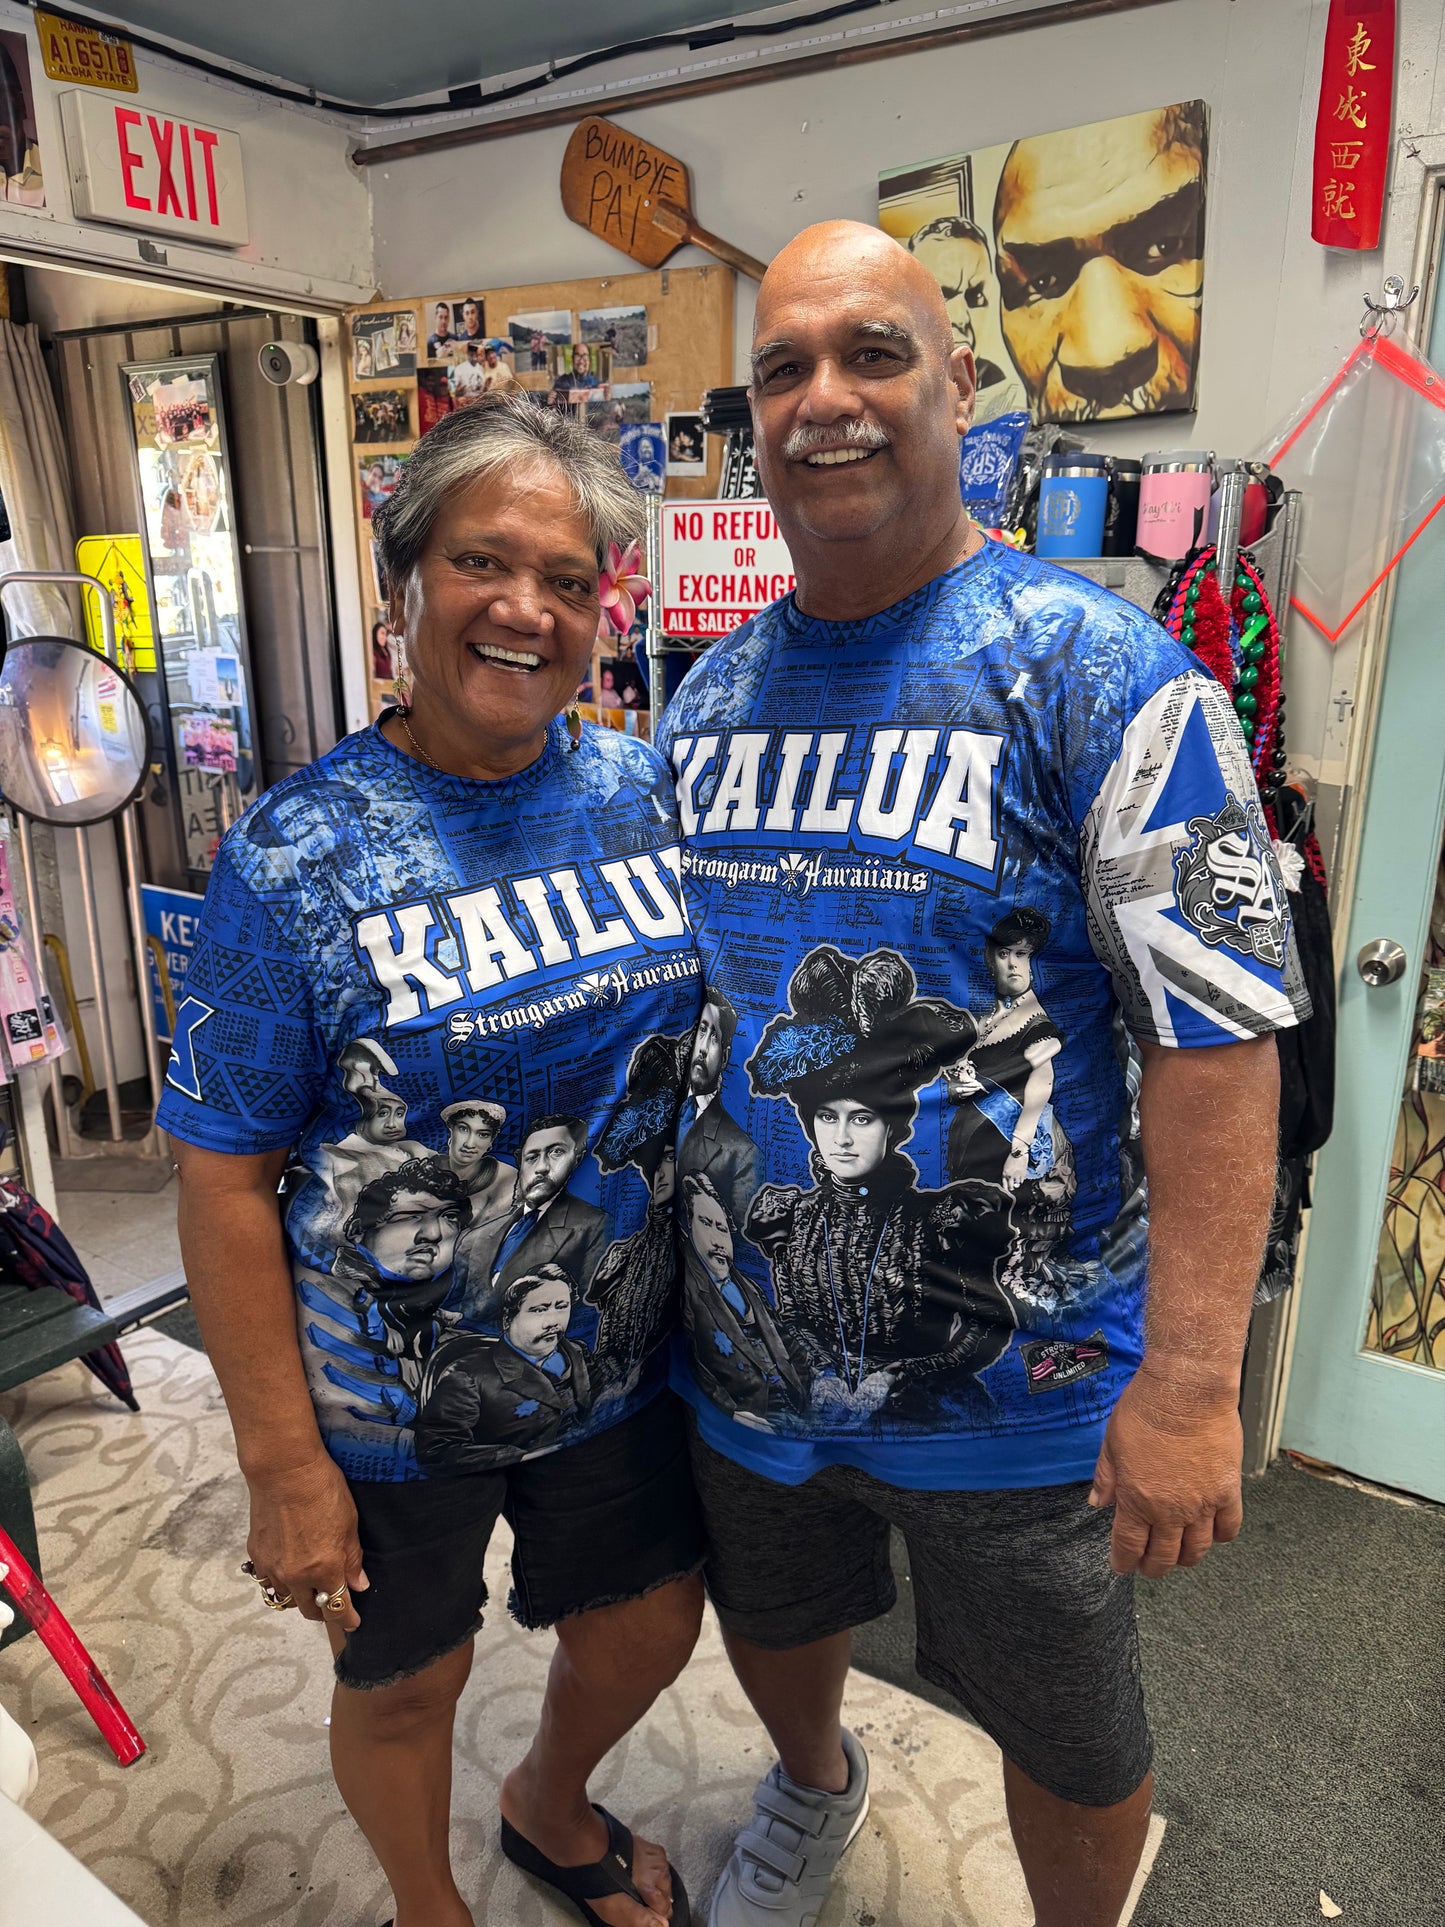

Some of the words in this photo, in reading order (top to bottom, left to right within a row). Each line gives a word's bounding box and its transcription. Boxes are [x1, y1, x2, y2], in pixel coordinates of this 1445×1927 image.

[59, 64, 92, 79] ALOHA
[97, 70, 128, 85] STATE
[1322, 22, 1377, 219] 東成西就
[115, 106, 219, 226] EXIT
[585, 125, 680, 199] BUMBYE
[674, 512, 703, 541] NO
[734, 548, 756, 567] OR
[669, 612, 694, 632] ALL
[673, 729, 1004, 872] KAILUA
[680, 849, 779, 888] Strongarm
[447, 990, 587, 1050] Strongarm
[1053, 1361, 1086, 1380] UNLIMITED
